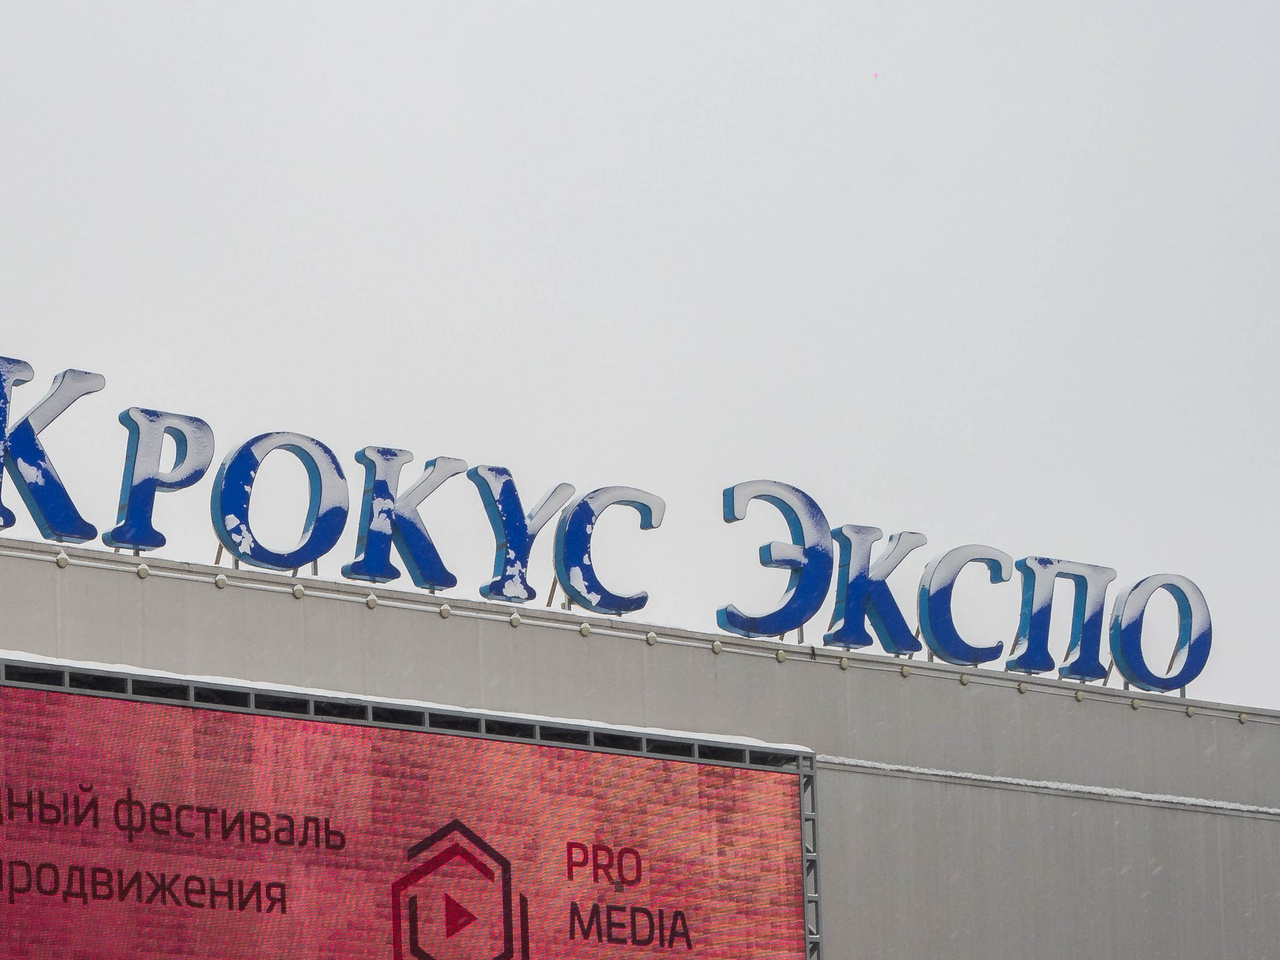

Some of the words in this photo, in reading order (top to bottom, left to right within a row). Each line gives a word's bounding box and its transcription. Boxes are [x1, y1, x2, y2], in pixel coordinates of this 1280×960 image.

[113, 787, 347, 851] фестиваль
[566, 841, 643, 887] PRO
[569, 901, 693, 950] MEDIA
